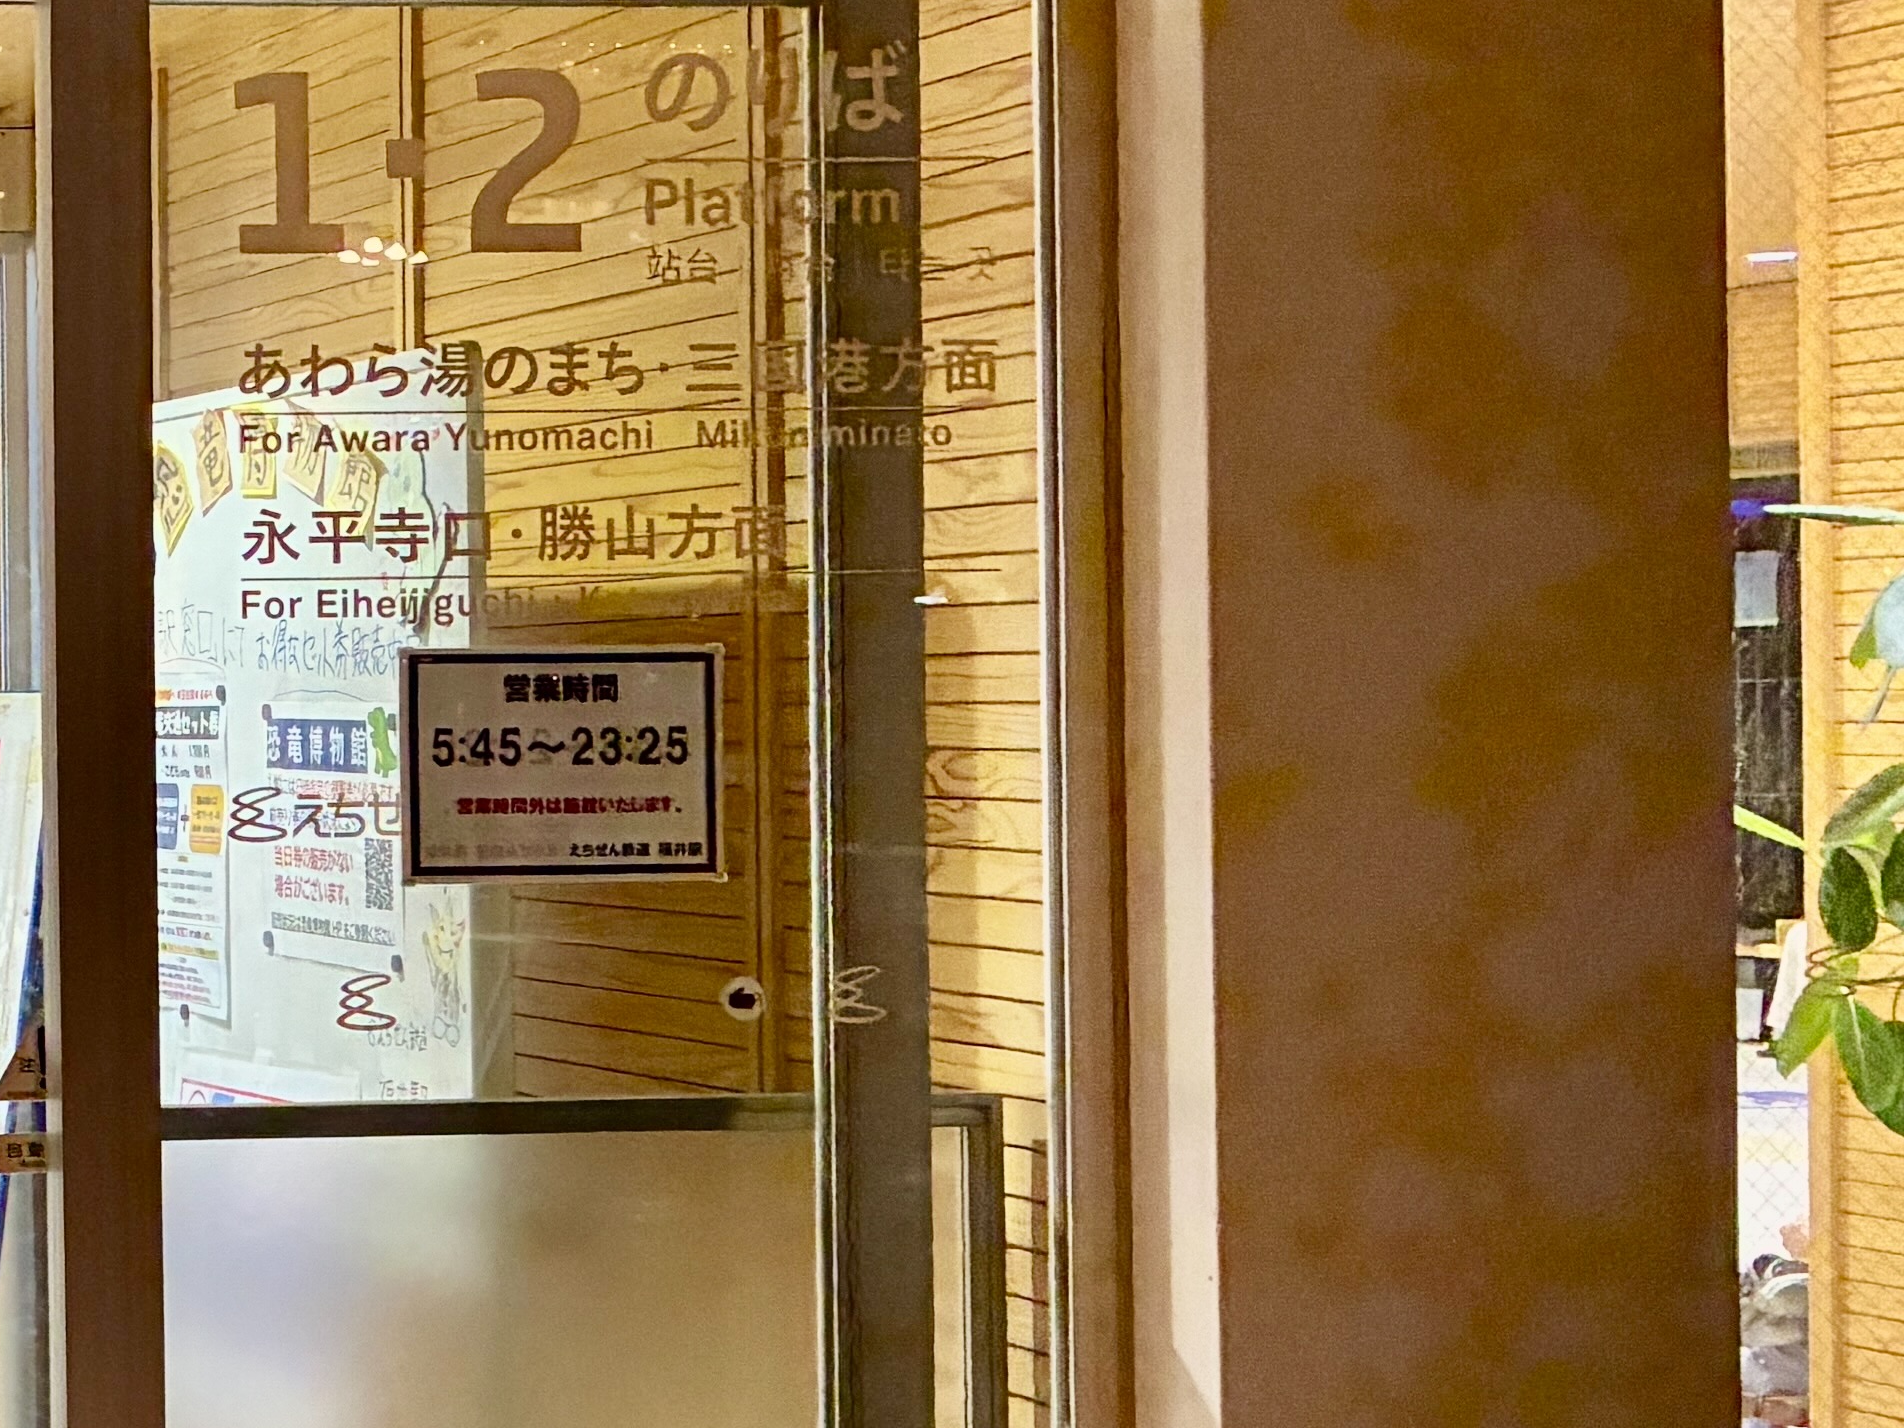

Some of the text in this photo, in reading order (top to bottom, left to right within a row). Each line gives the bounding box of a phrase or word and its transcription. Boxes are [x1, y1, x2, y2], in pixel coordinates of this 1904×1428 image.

[240, 424, 299, 454] For
[313, 424, 430, 454] Awara
[445, 420, 653, 452] Yunomachi
[242, 506, 787, 565] 永平寺口・勝山方面
[241, 590, 300, 619] For
[503, 673, 619, 704] 営業時間
[266, 725, 367, 767] 恐竜博物館
[569, 842, 650, 858] えちぜん鉄道
